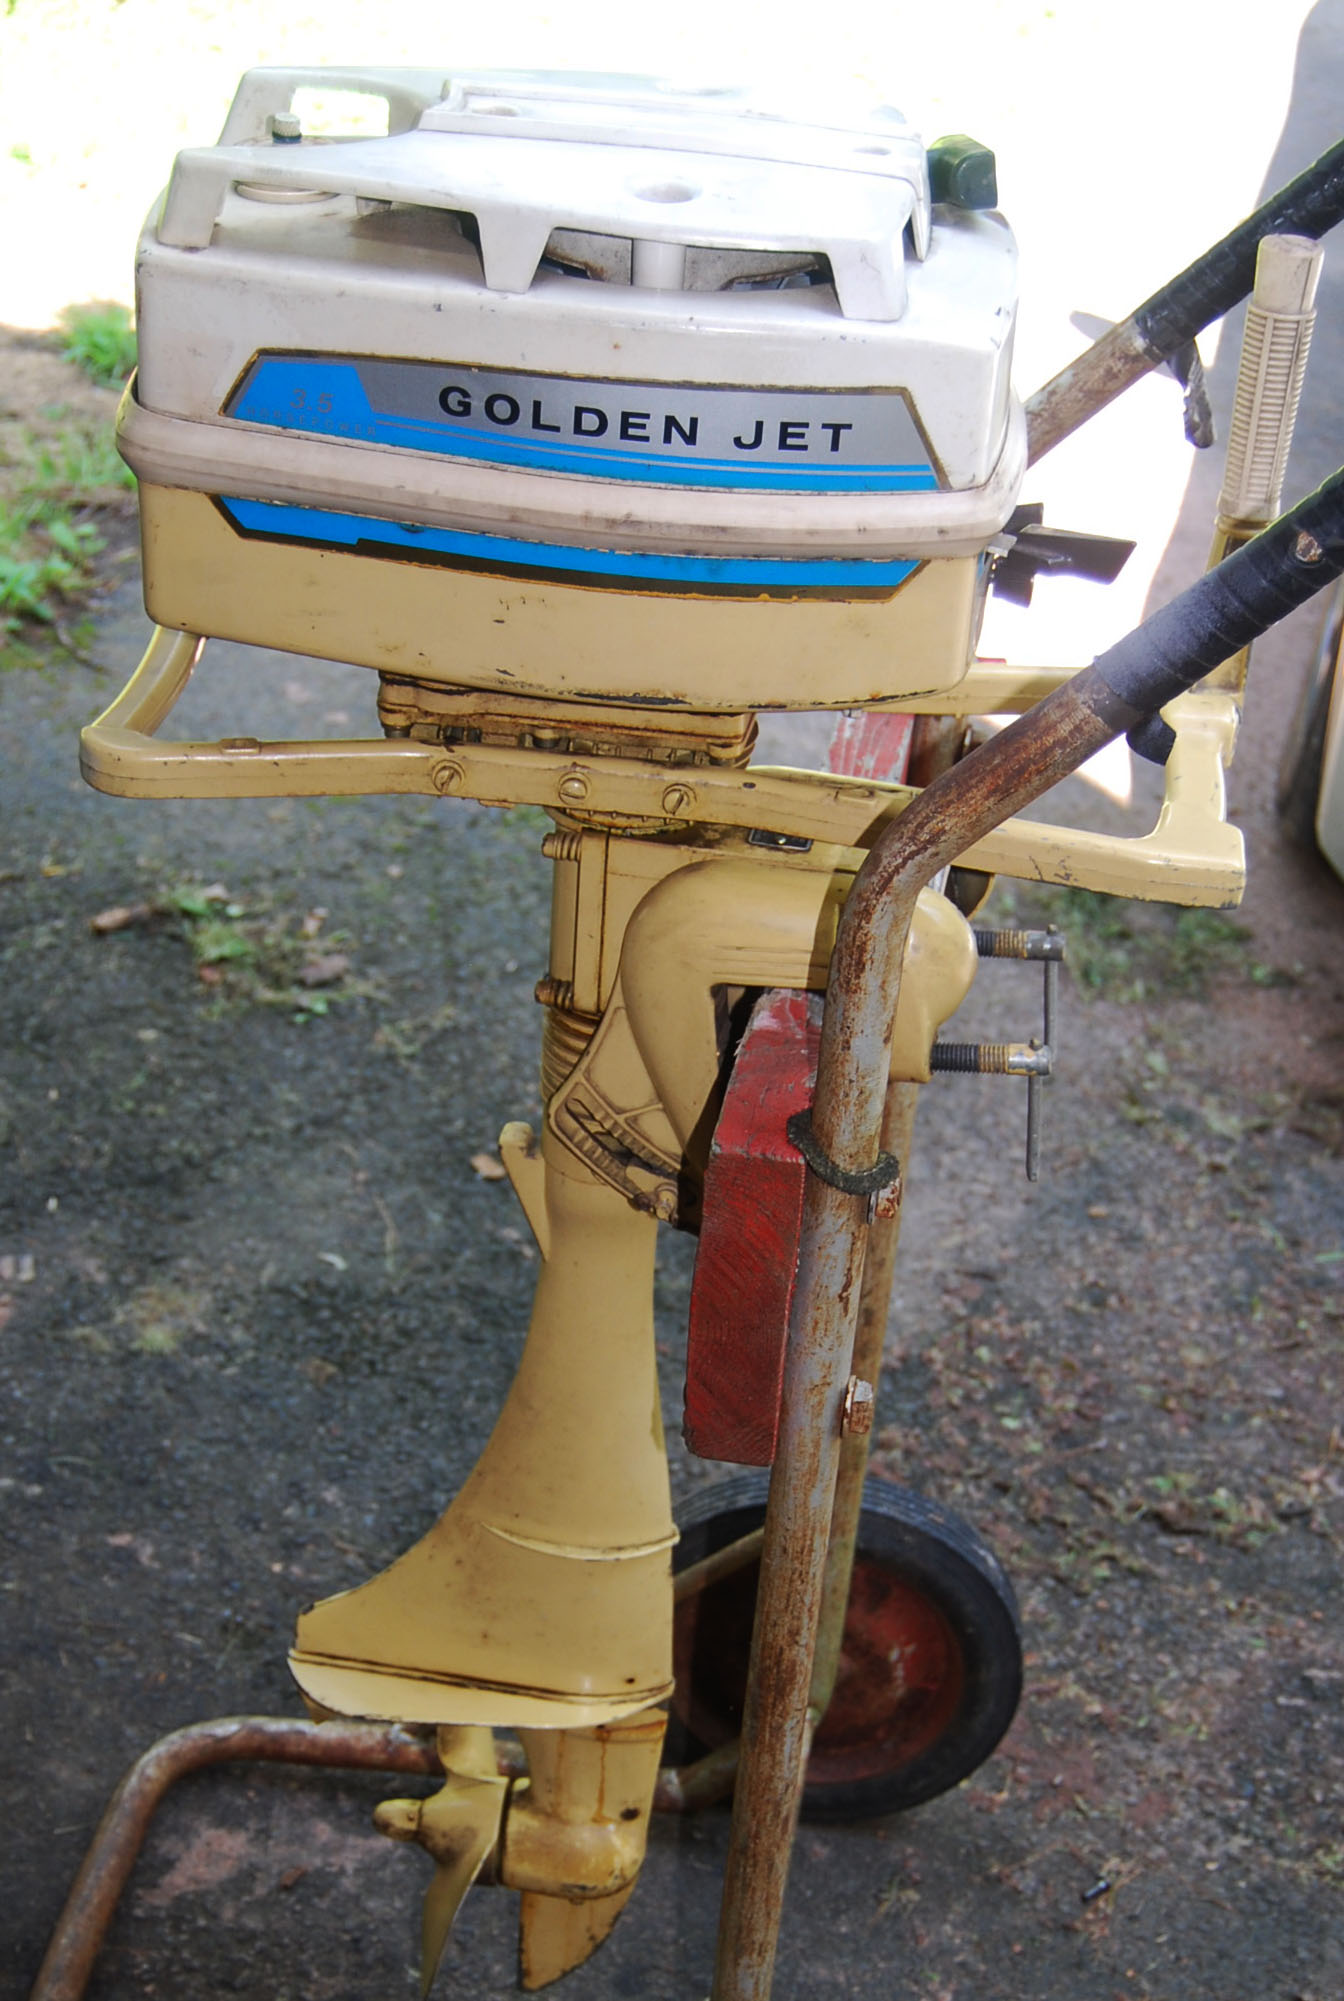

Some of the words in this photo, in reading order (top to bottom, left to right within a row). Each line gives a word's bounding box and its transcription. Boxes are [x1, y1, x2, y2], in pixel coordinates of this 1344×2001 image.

[289, 387, 335, 414] 3.5
[438, 385, 699, 446] GOLDEN
[733, 420, 853, 452] JET
